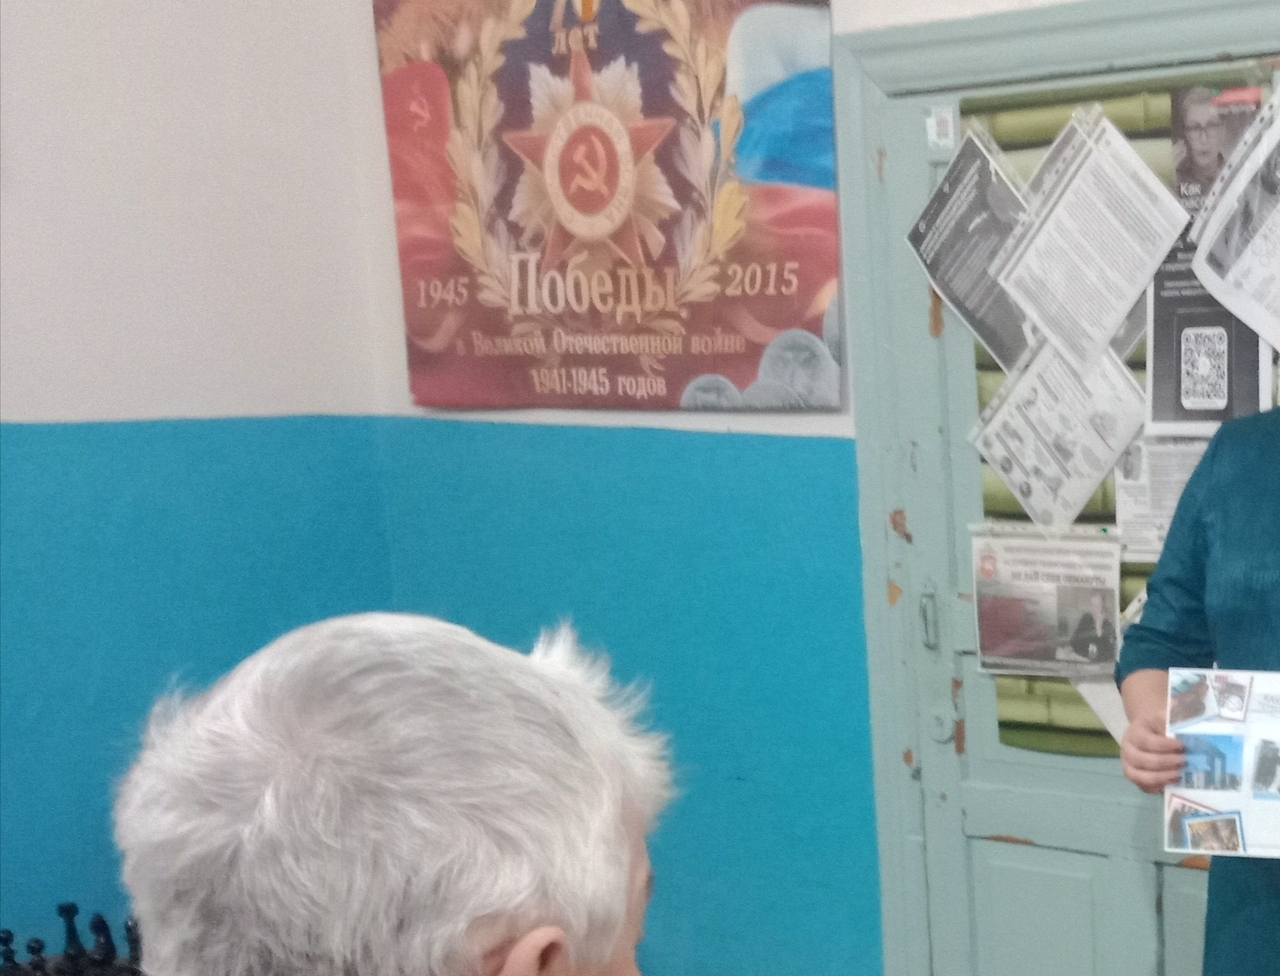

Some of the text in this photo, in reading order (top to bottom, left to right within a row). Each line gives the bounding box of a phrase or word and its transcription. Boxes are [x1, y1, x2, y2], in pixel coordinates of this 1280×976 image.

[417, 276, 469, 308] 1945
[508, 250, 679, 324] Победы
[725, 260, 800, 297] 2015
[553, 327, 683, 356] Отечественной
[690, 326, 746, 356] войне
[617, 375, 667, 399] годов
